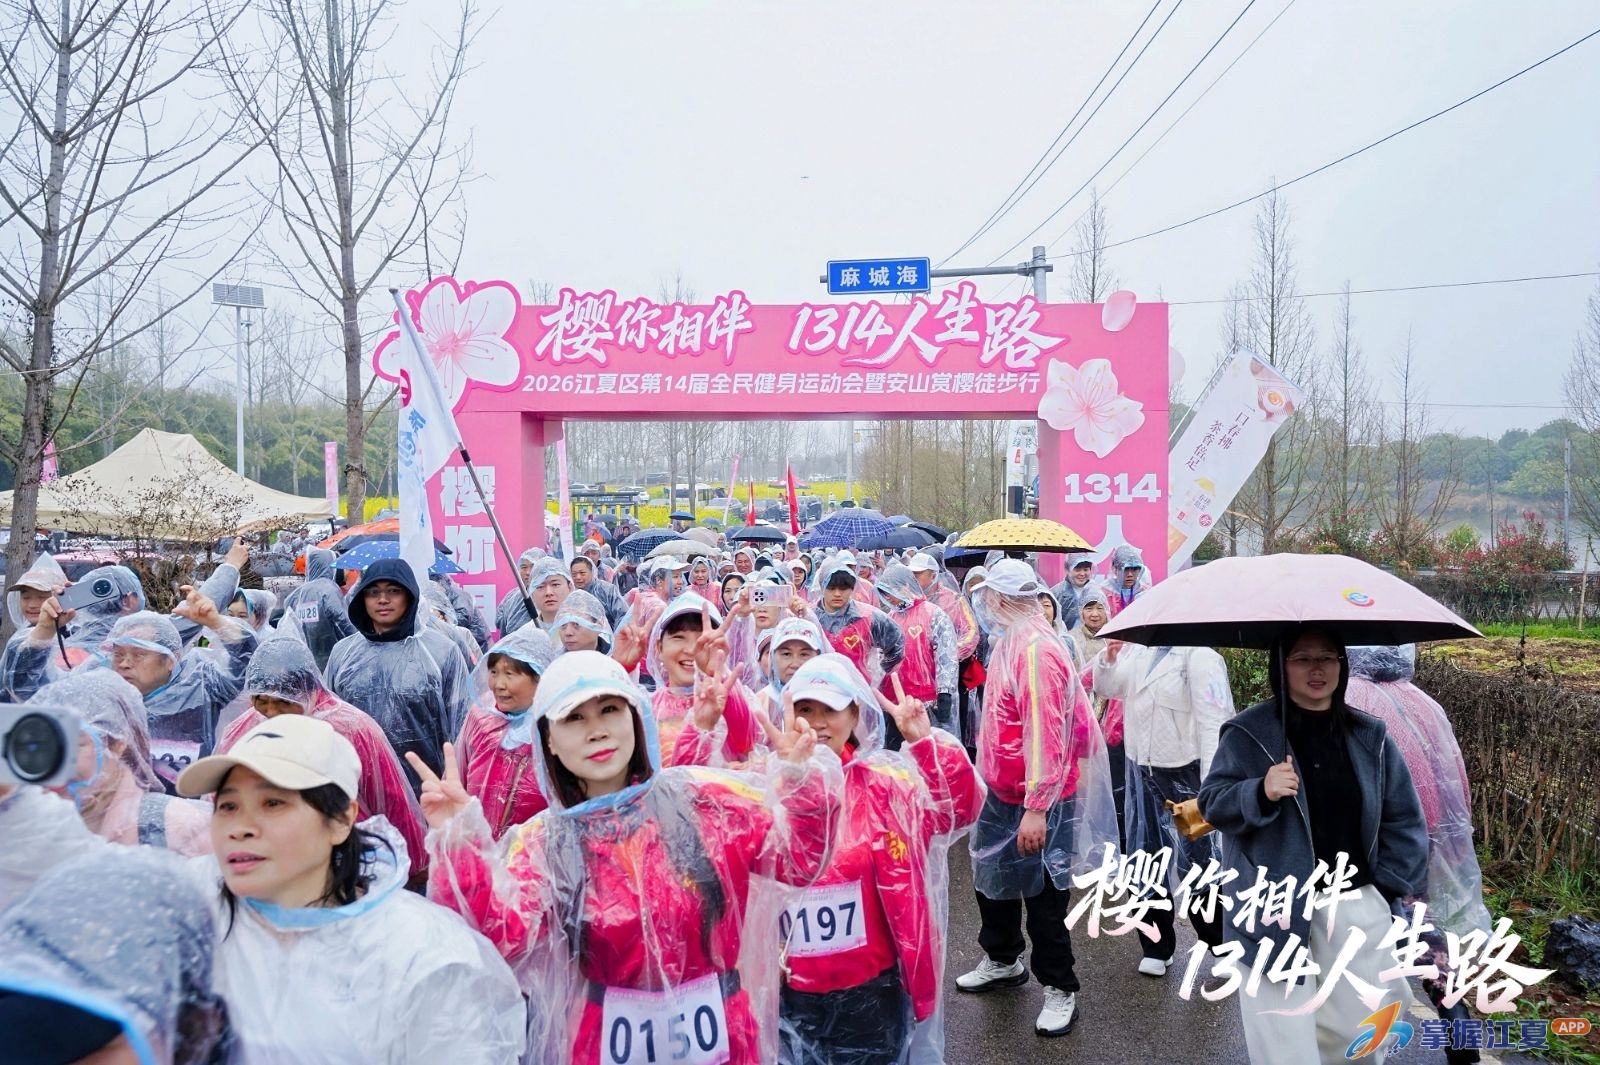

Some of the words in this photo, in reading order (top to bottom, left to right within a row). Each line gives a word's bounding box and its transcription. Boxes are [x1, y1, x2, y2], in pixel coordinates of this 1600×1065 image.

[840, 266, 918, 286] 麻城海
[535, 291, 753, 364] 樱你相伴
[788, 285, 1066, 369] 1314人生路
[522, 372, 1041, 395] 2026江夏区第14届全民健身运动会暨安山赏樱徒步行
[1064, 473, 1161, 503] 1314
[609, 1004, 718, 1065] 0150
